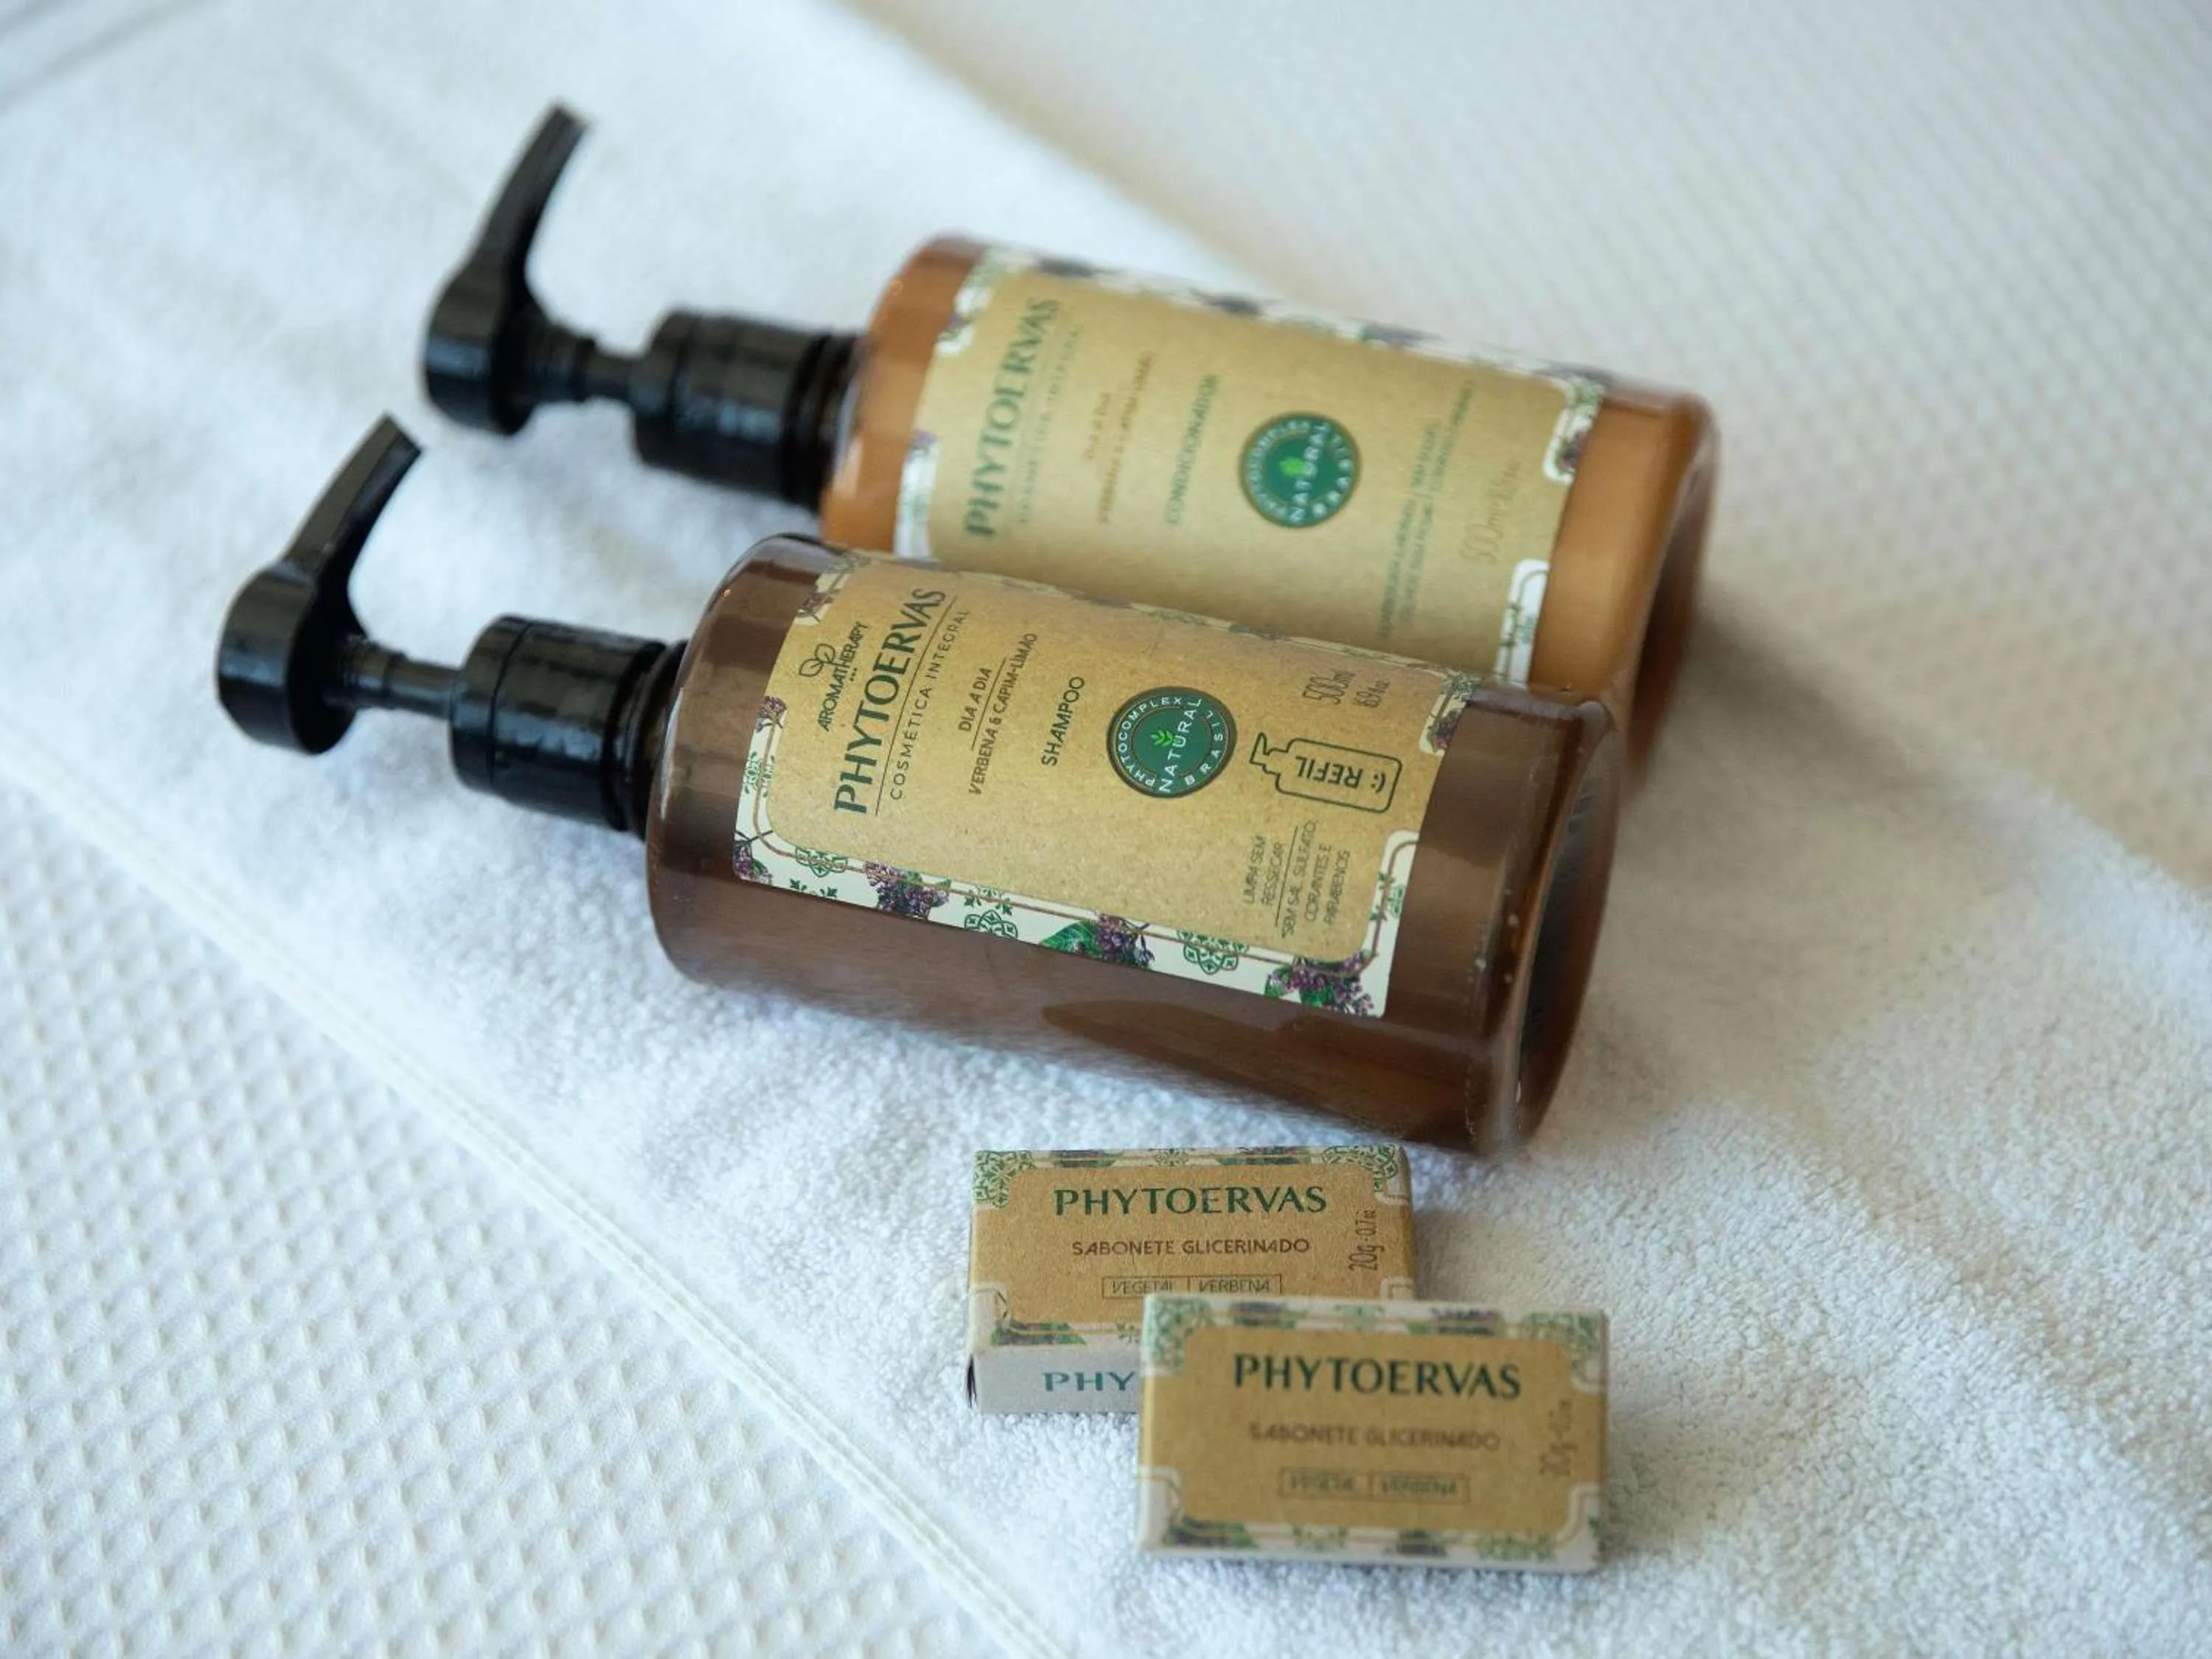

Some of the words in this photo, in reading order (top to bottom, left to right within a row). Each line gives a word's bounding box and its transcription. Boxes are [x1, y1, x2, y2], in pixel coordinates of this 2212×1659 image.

[817, 621, 869, 732] AROMATHERAPY
[925, 610, 970, 679] INTEGRAL
[834, 588, 946, 813] PHYTOERVAS
[969, 692, 982, 704] A
[973, 667, 992, 690] DIA
[959, 706, 978, 731] DIA
[1041, 676, 1085, 767] SHAMPOO
[1119, 697, 1182, 787] PHYTOCOMPLEX
[1158, 698, 1203, 793] NATURAL
[1185, 710, 1224, 785] BRASIL
[968, 726, 998, 795] VERBENA
[1295, 754, 1363, 790] REFIL
[1250, 835, 1266, 865] SEM
[1262, 841, 1284, 906] RESSECAR
[1304, 855, 1330, 922] CORANTES
[1324, 850, 1351, 925] PARABENOS
[1054, 1186, 1327, 1215] PHYTOERVAS
[1072, 1239, 1175, 1256] SABONETE
[1182, 1238, 1310, 1255] GLICERINADO
[1198, 1278, 1270, 1293] VERBENA
[1233, 1353, 1522, 1400] PHYTOERVAS
[1249, 1422, 1358, 1446] SABONETE
[1364, 1426, 1501, 1453] GLICERINADO
